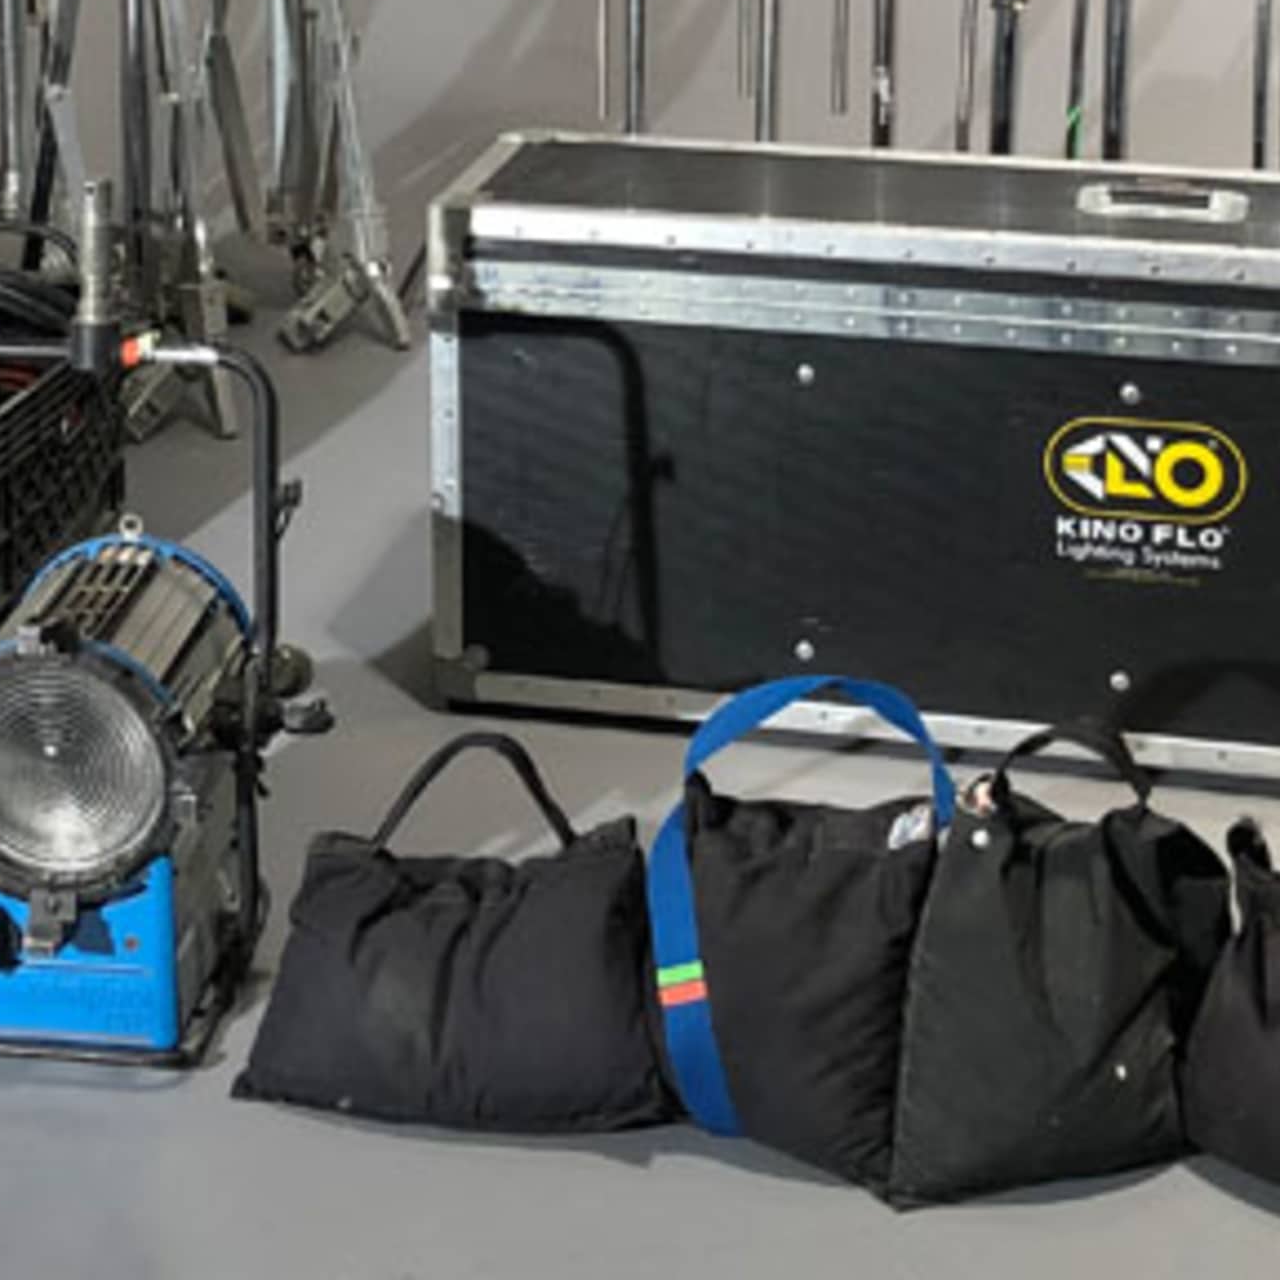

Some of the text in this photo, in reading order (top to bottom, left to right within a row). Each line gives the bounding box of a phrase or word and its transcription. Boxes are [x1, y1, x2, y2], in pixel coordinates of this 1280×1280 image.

[1056, 516, 1224, 549] KINO FLO
[1057, 540, 1221, 569] Lighting Systems
